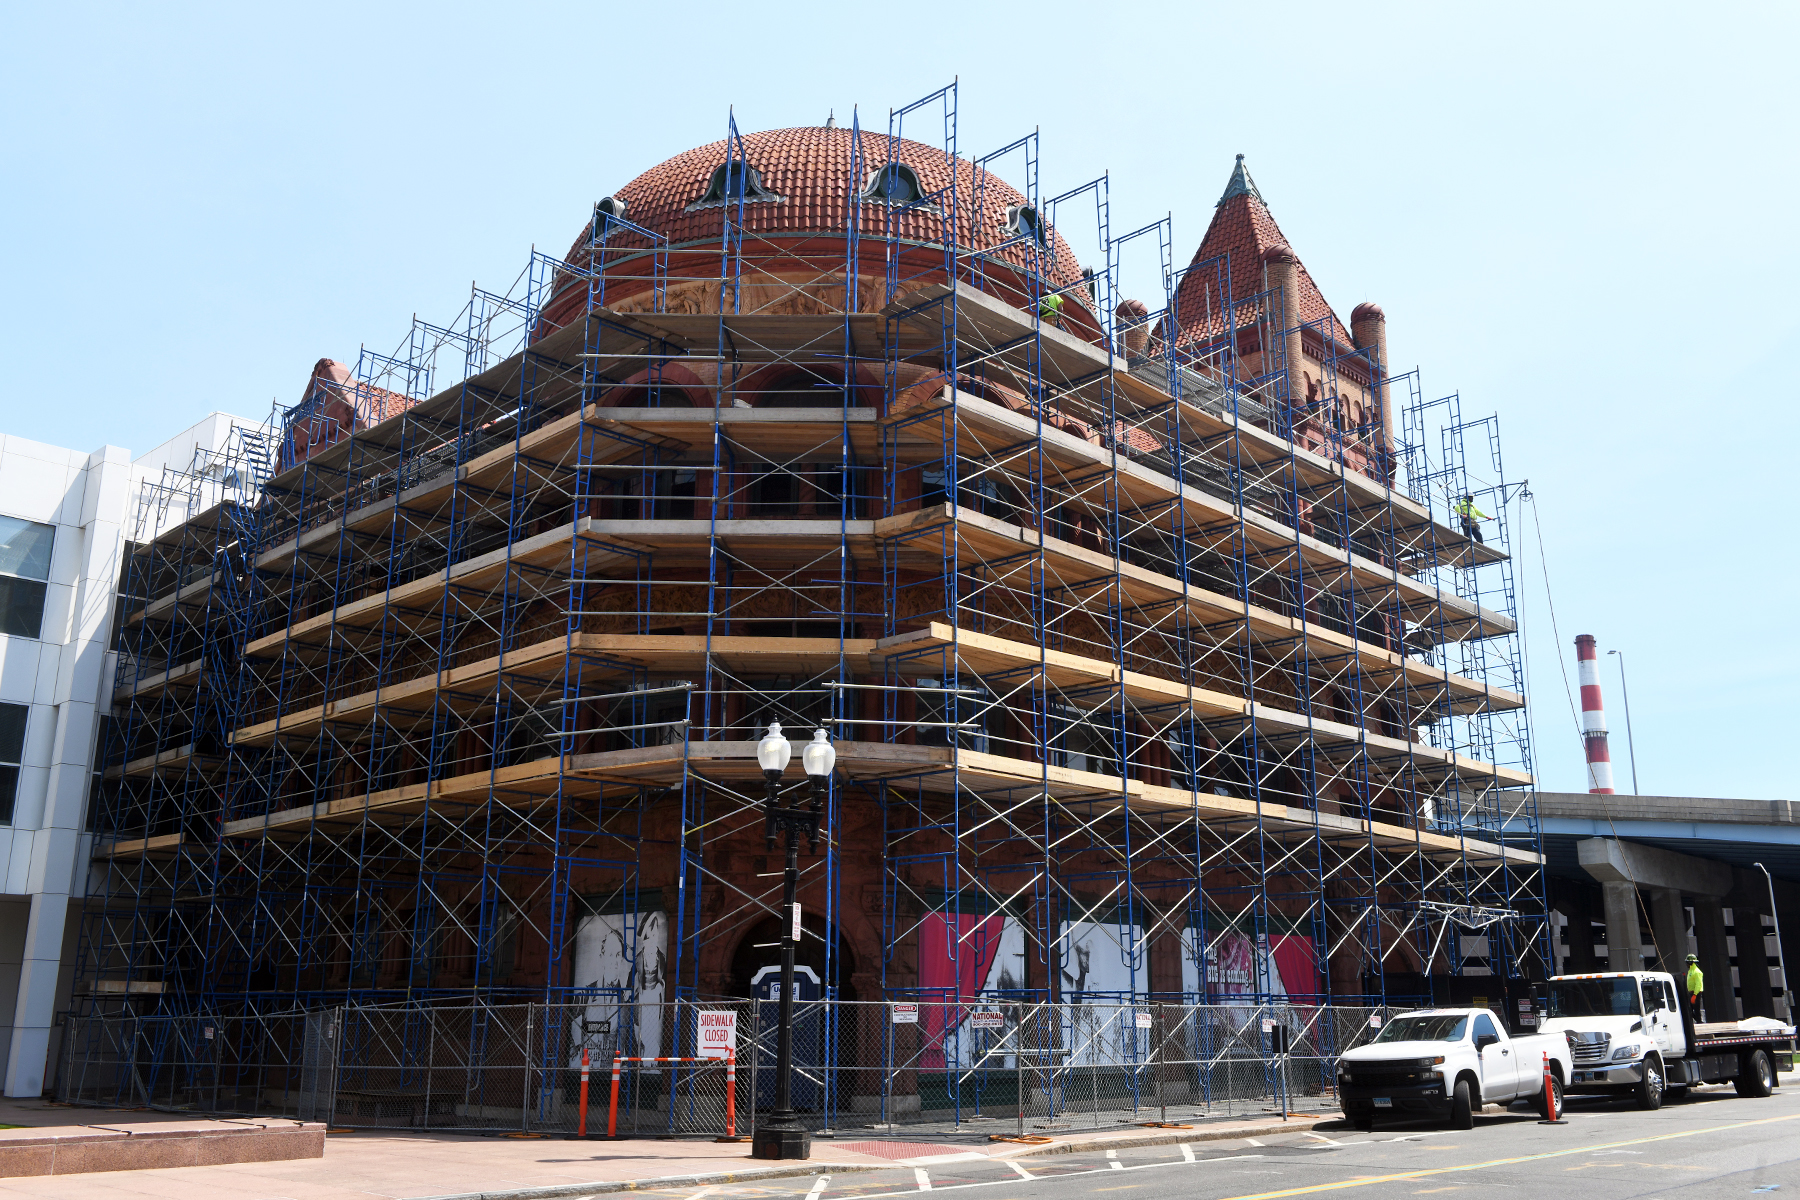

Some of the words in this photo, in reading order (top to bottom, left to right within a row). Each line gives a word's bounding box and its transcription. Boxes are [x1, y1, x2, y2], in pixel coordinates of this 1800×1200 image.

[1207, 965, 1218, 983] BIG
[1220, 966, 1226, 983] is
[700, 1014, 734, 1026] SIDEWALK
[972, 1012, 1003, 1020] NATIONAL
[704, 1029, 729, 1042] CLOSED
